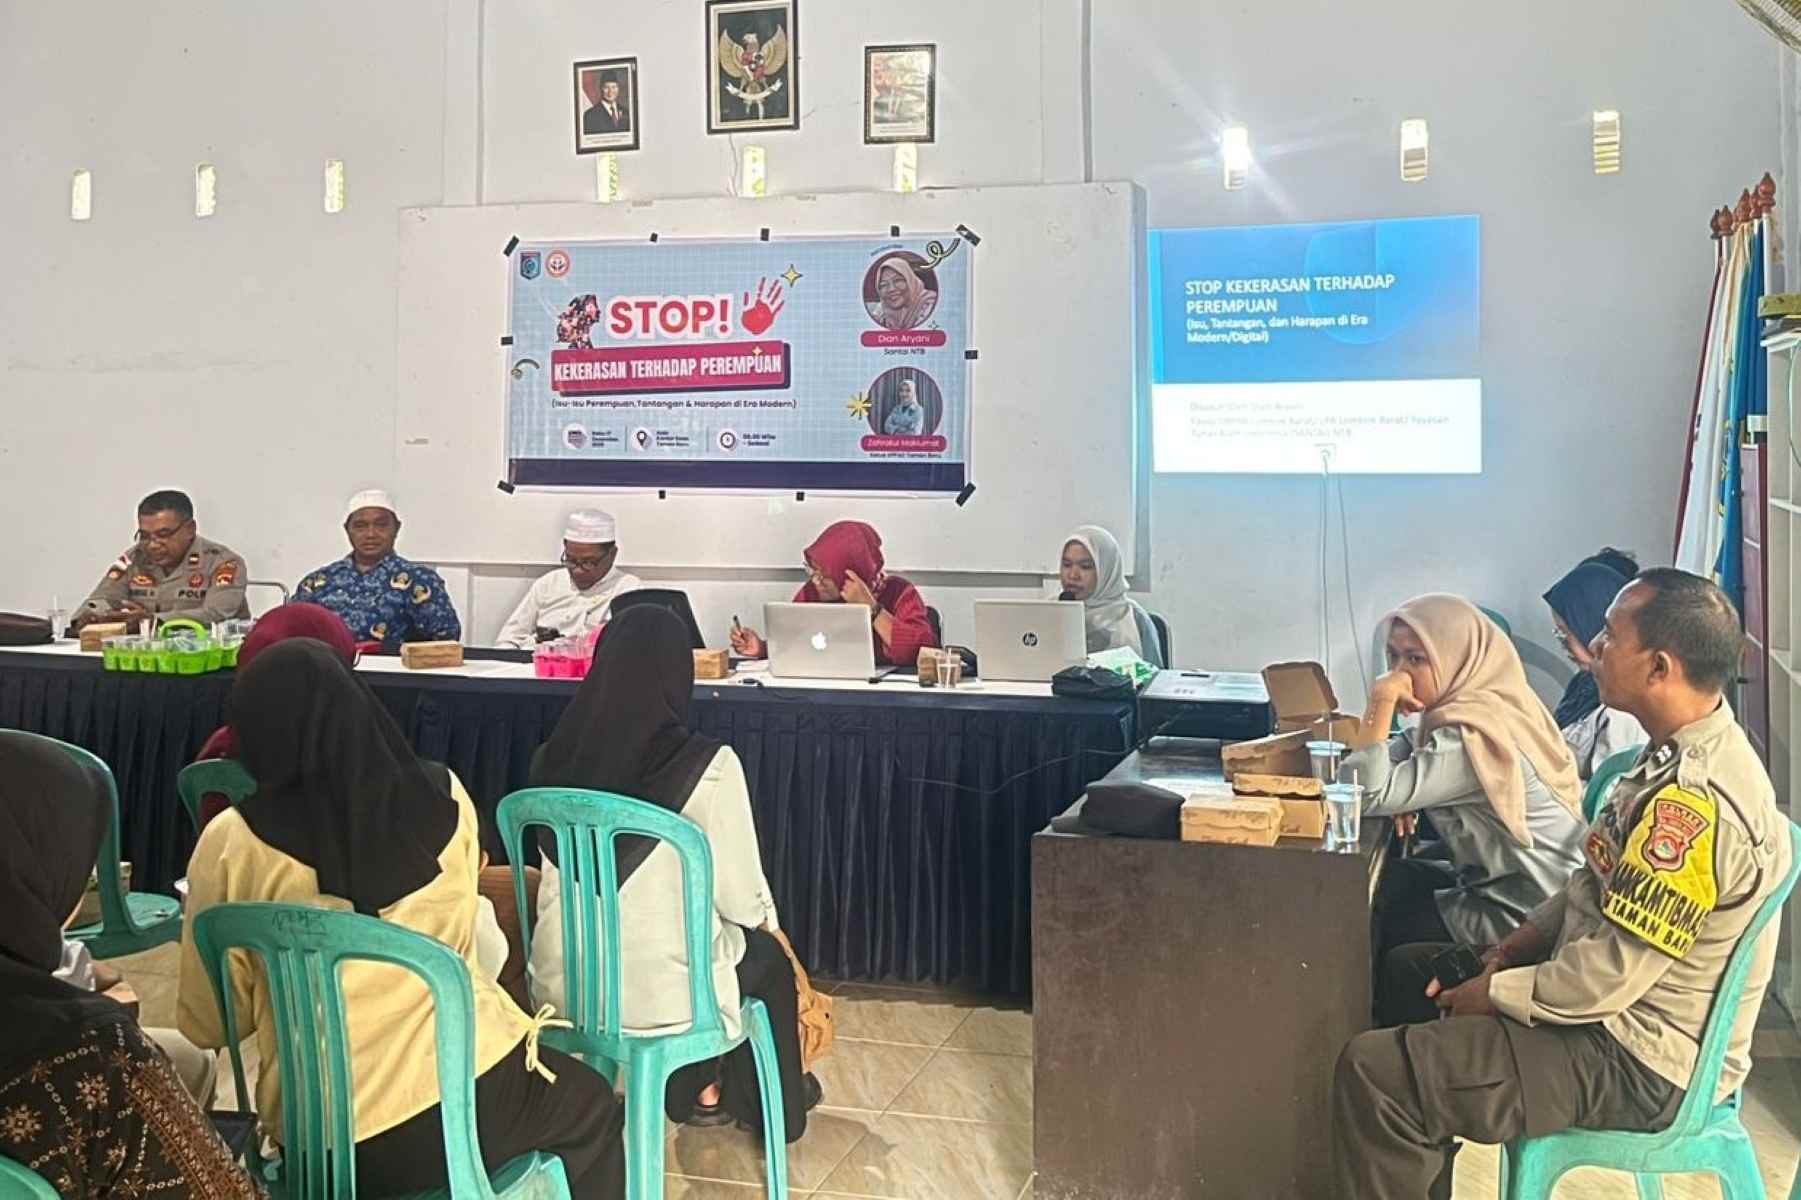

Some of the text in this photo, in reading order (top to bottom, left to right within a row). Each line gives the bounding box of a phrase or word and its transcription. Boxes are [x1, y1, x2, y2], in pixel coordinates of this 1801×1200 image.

[1185, 273, 1395, 295] STOP KEKERASAN TERHADAP
[1186, 298, 1278, 314] PEREMPUAN
[610, 299, 728, 334] STOP!
[1268, 316, 1289, 327] dan
[1291, 315, 1336, 328] Harapan
[1337, 314, 1348, 326] di
[1350, 314, 1368, 326] Era
[878, 334, 930, 344] Dian Aryani
[1187, 331, 1269, 344] Modern/Digital)
[554, 354, 782, 381] KEKERASAN TERHADAP PEREMPUAN
[694, 400, 732, 409] Harapan
[1612, 899, 1661, 937] TAMAN
